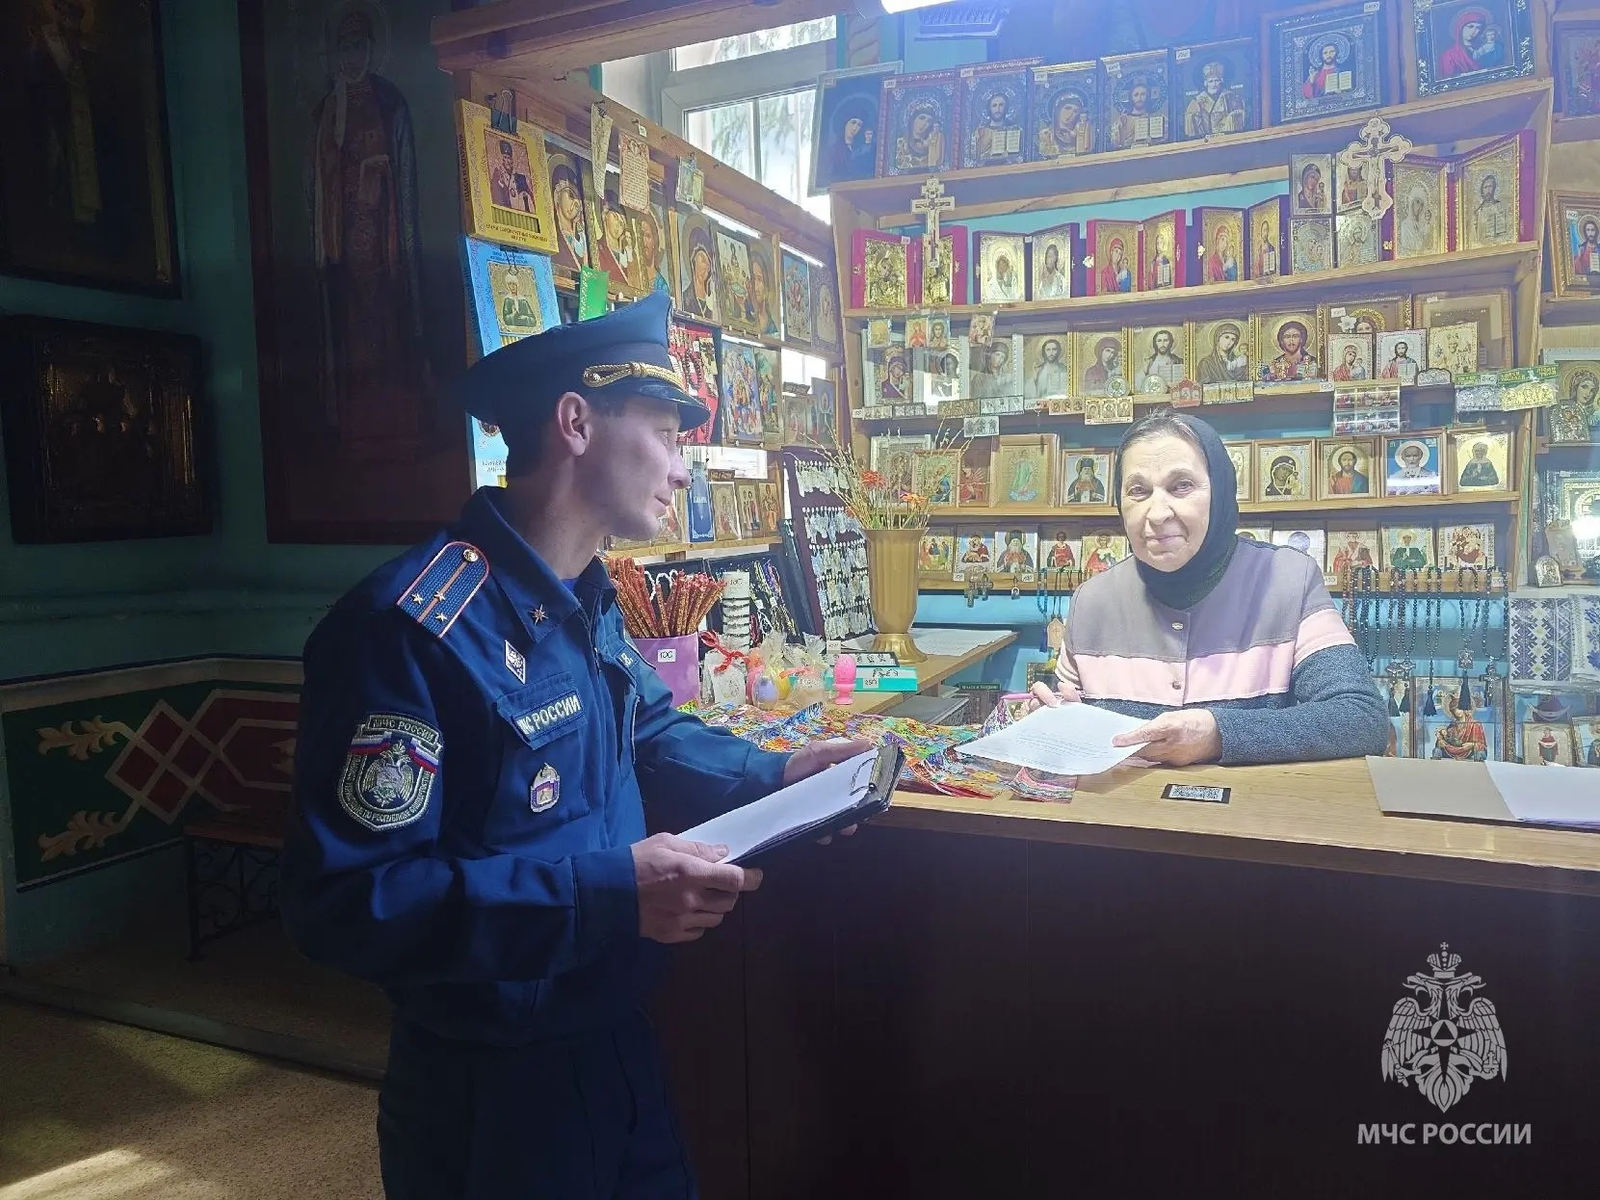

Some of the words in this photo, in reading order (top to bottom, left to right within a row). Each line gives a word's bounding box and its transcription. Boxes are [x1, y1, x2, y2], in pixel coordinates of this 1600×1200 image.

[531, 694, 582, 730] РОССИИ
[372, 718, 396, 729] МЧС
[397, 720, 436, 742] РОССИИ
